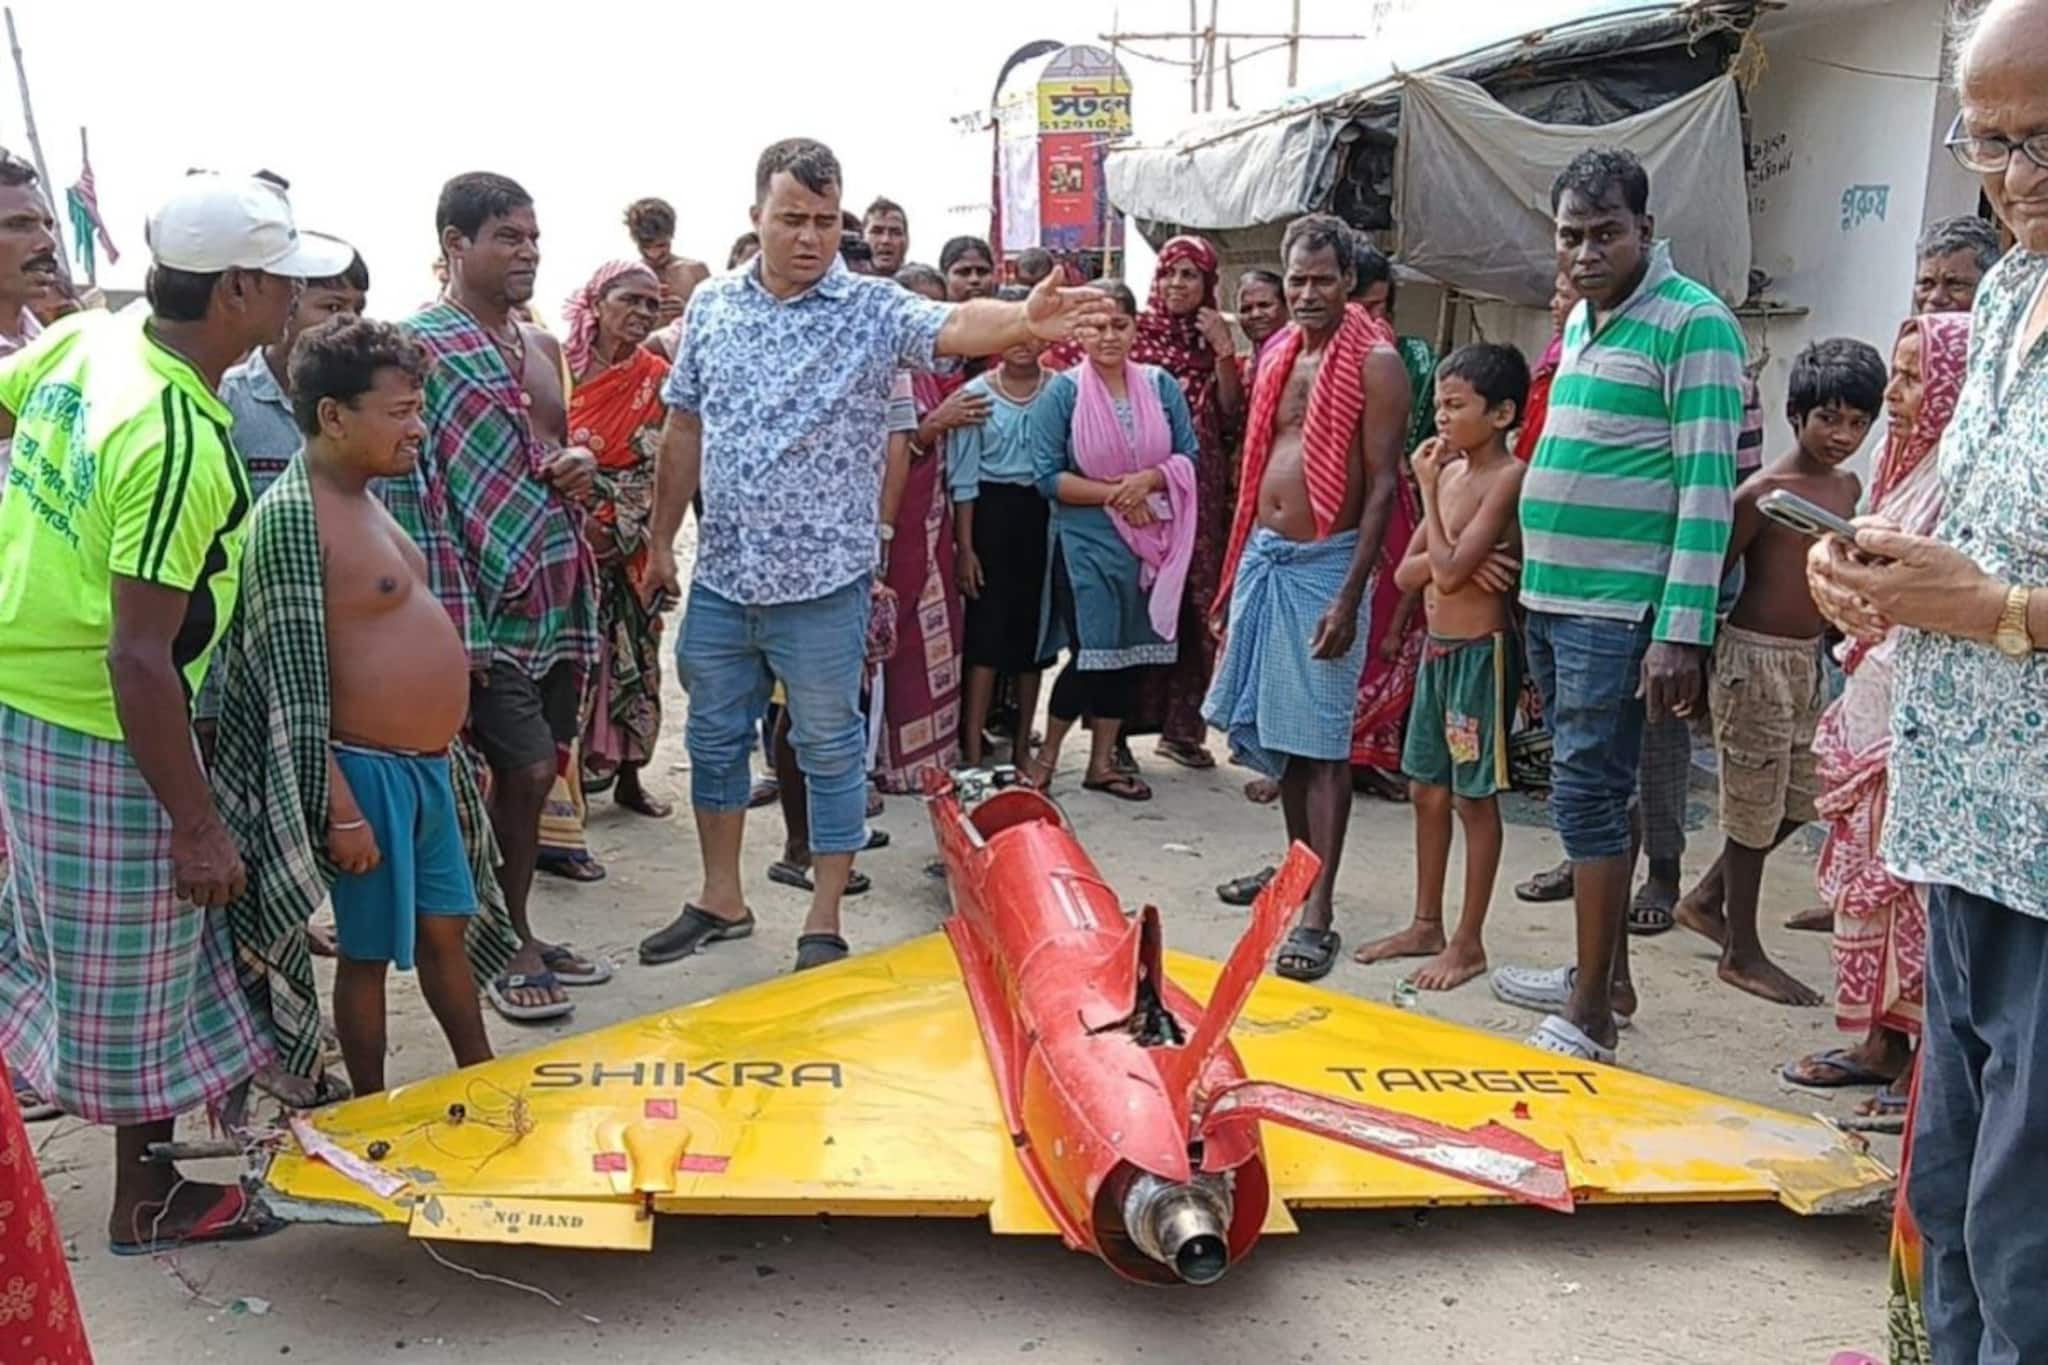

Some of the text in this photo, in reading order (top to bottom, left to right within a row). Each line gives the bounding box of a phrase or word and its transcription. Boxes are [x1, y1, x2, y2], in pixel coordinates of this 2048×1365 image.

[530, 1062, 843, 1088] SHIKRA
[1325, 1067, 1599, 1095] TARGET
[495, 1211, 584, 1228] NO HAND
